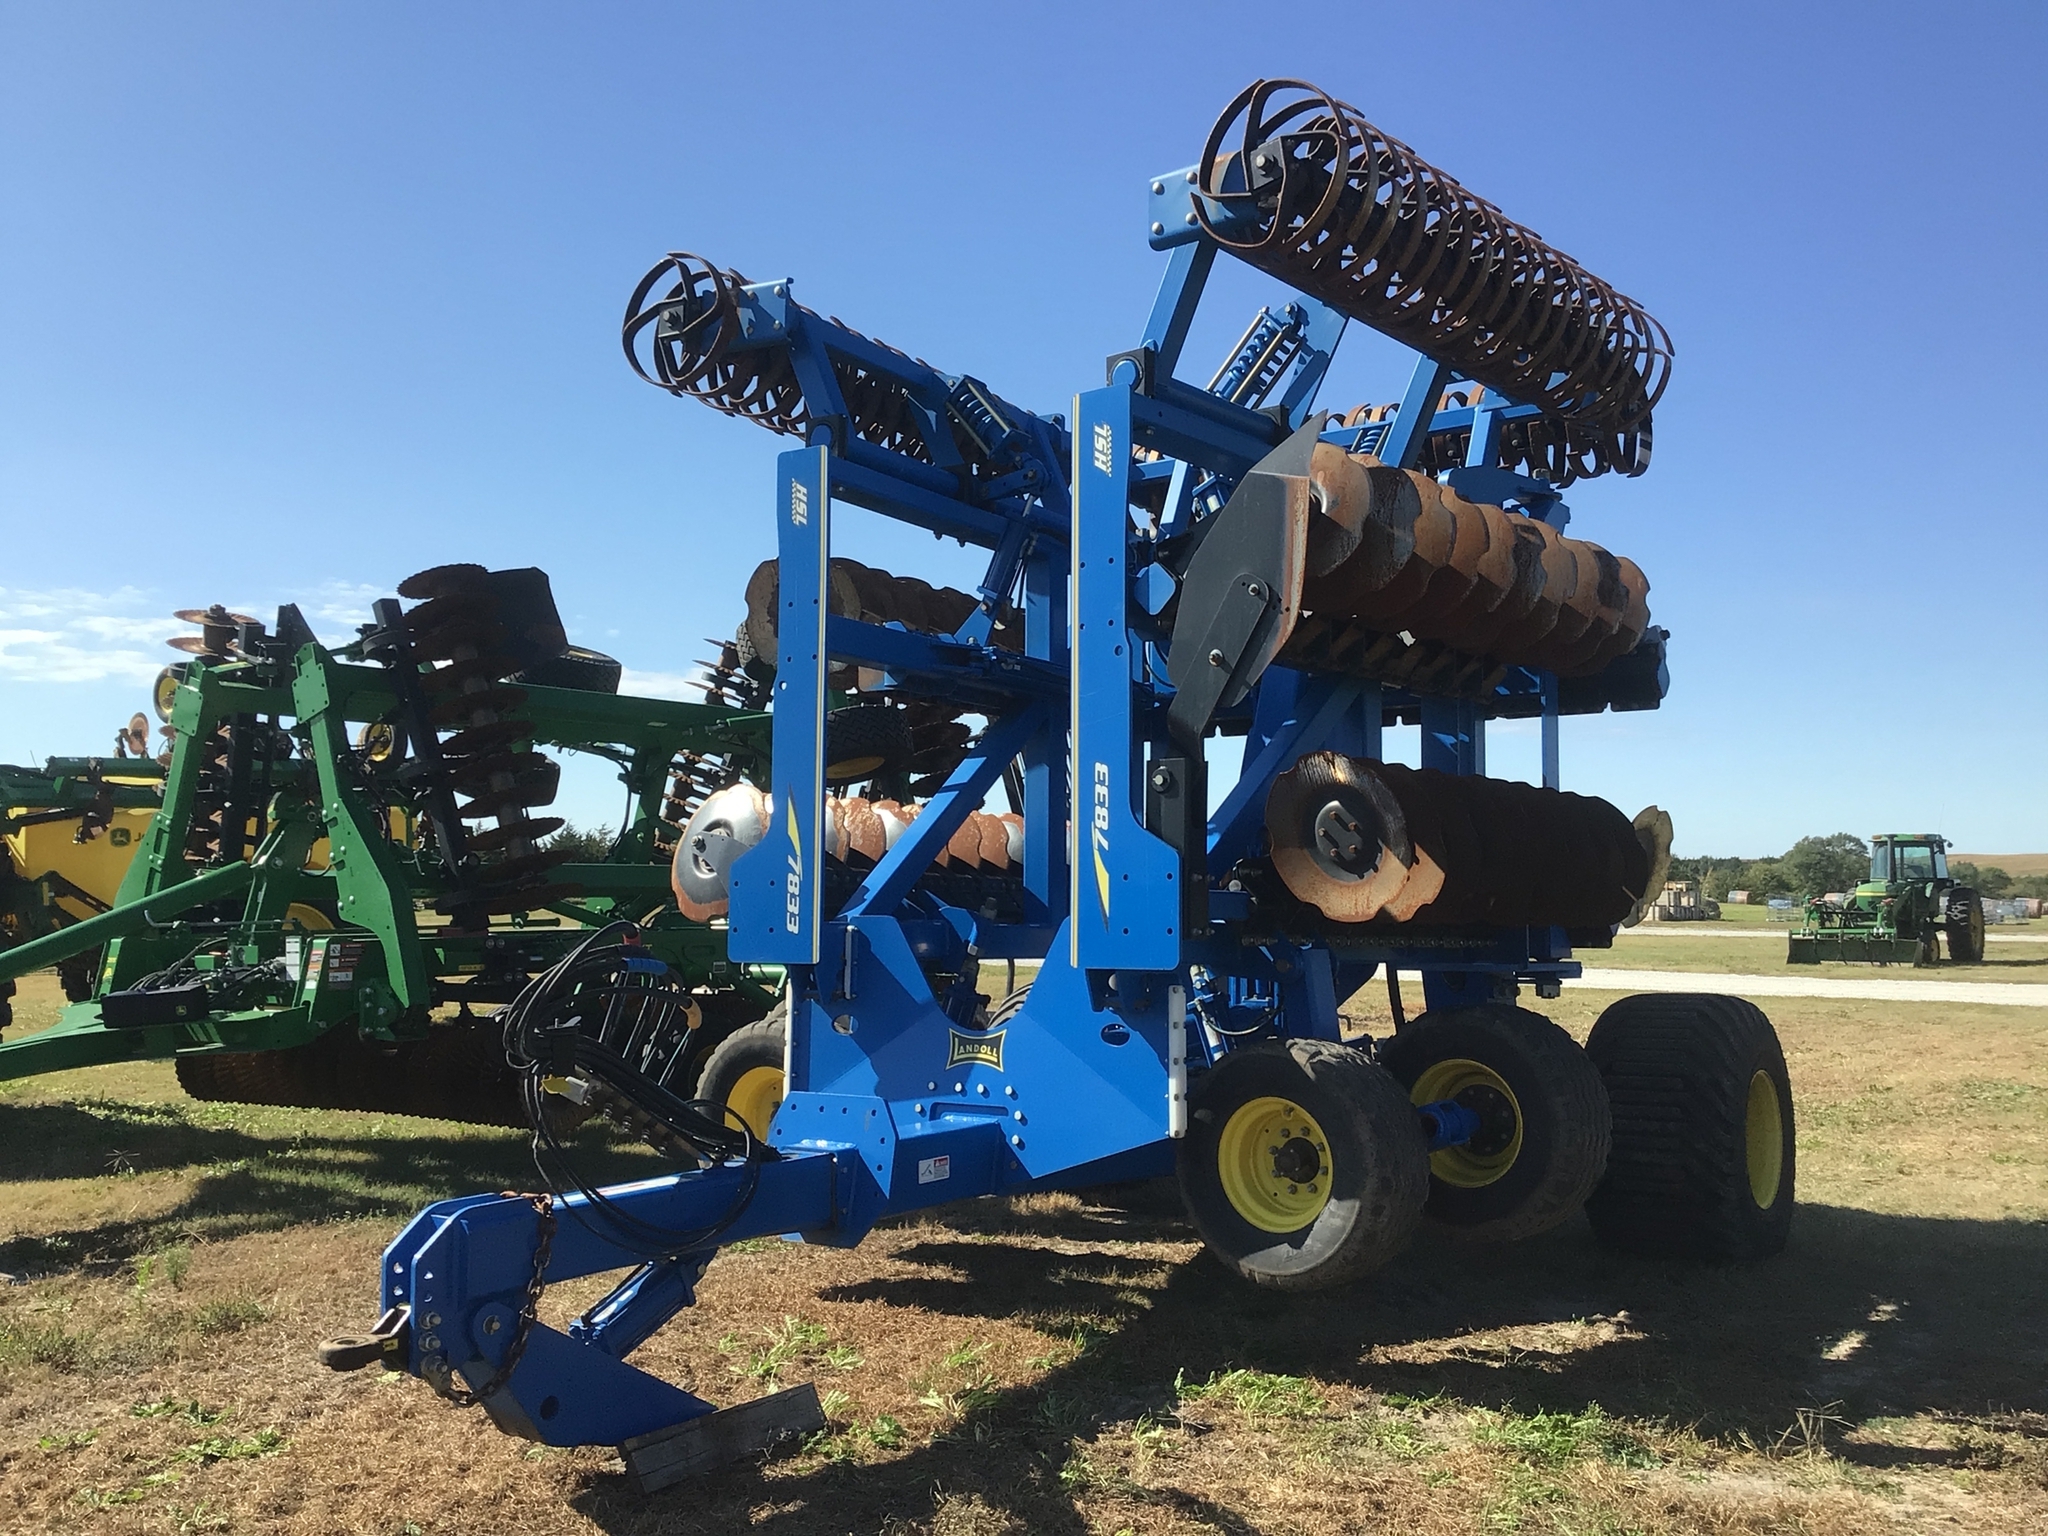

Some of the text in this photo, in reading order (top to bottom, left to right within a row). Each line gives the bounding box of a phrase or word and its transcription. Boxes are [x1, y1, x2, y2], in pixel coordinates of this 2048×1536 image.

[1093, 422, 1108, 472] HSL
[795, 482, 808, 527] HSL
[1094, 761, 1109, 851] 7833
[786, 854, 801, 935] 7833
[953, 1037, 998, 1062] LANDOLL
